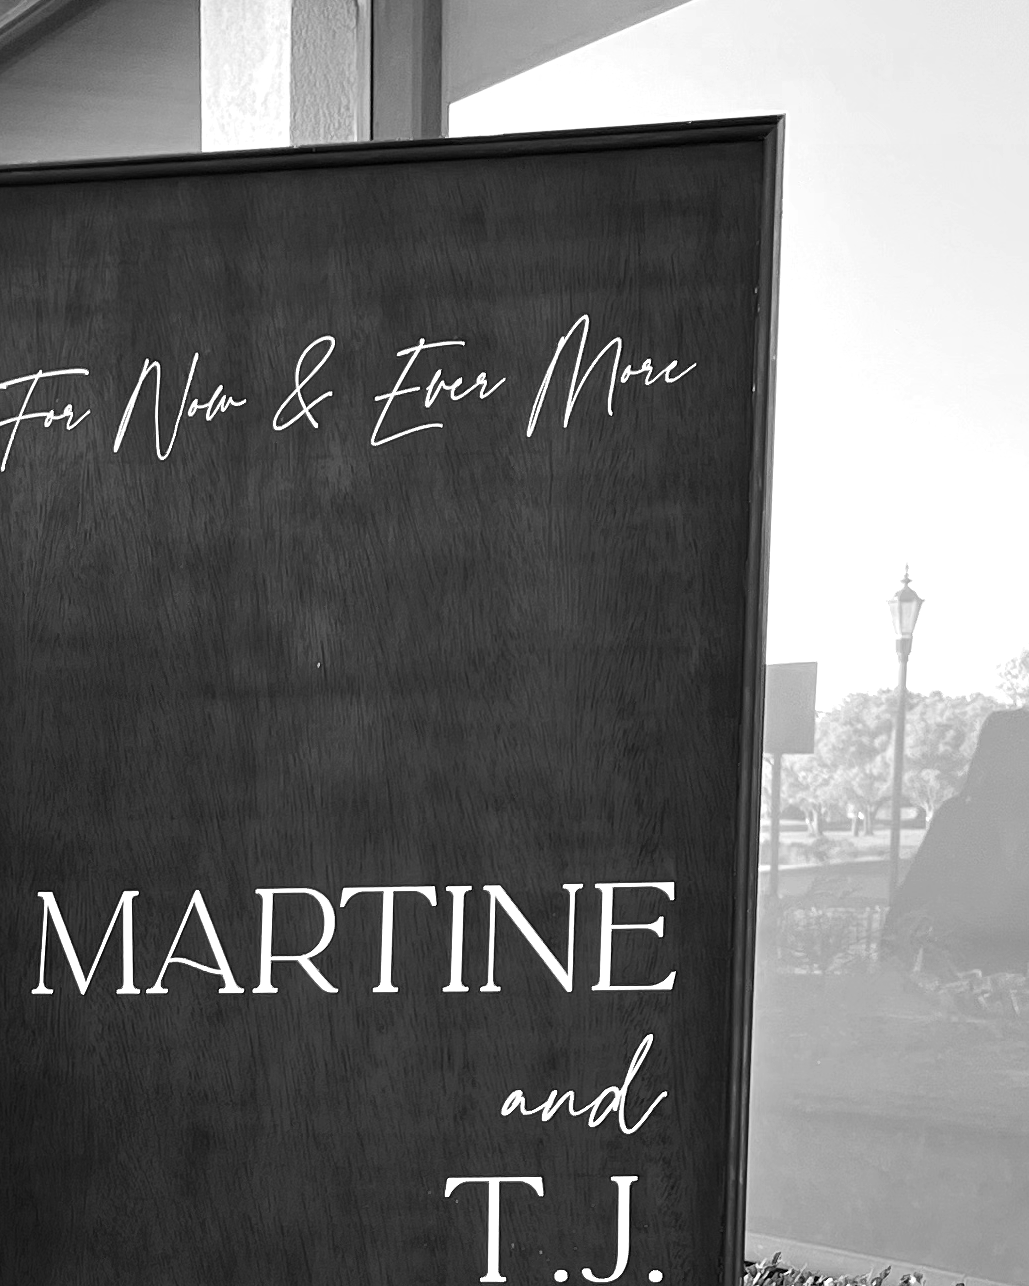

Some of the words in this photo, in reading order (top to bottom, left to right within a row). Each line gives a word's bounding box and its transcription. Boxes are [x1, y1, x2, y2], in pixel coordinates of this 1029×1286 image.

[112, 351, 247, 461] Now
[272, 335, 336, 432] &
[370, 337, 507, 447] Ever
[526, 313, 697, 438] More
[30, 881, 677, 996] MARTINE
[500, 1033, 668, 1135] and
